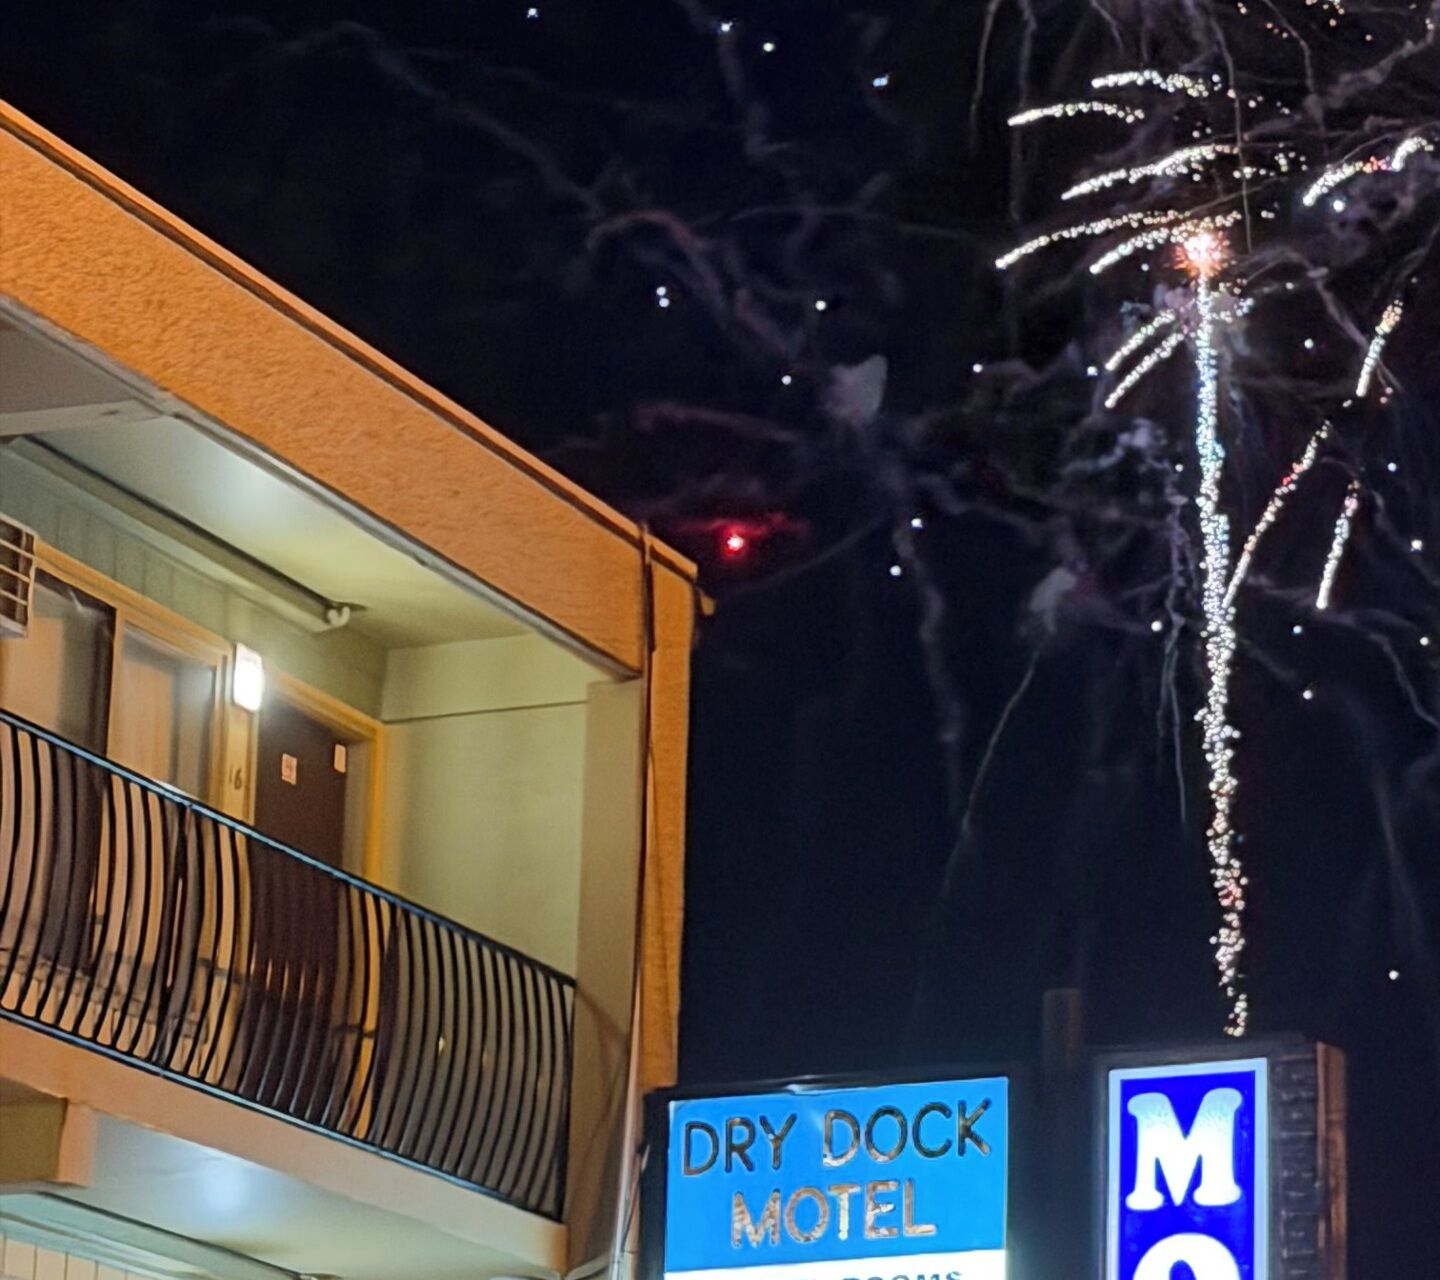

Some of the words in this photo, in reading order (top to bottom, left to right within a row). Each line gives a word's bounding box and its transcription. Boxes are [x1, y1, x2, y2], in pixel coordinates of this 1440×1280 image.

[682, 1113, 797, 1177] DRY
[822, 1098, 992, 1168] DOCK
[731, 1177, 938, 1248] MOTEL
